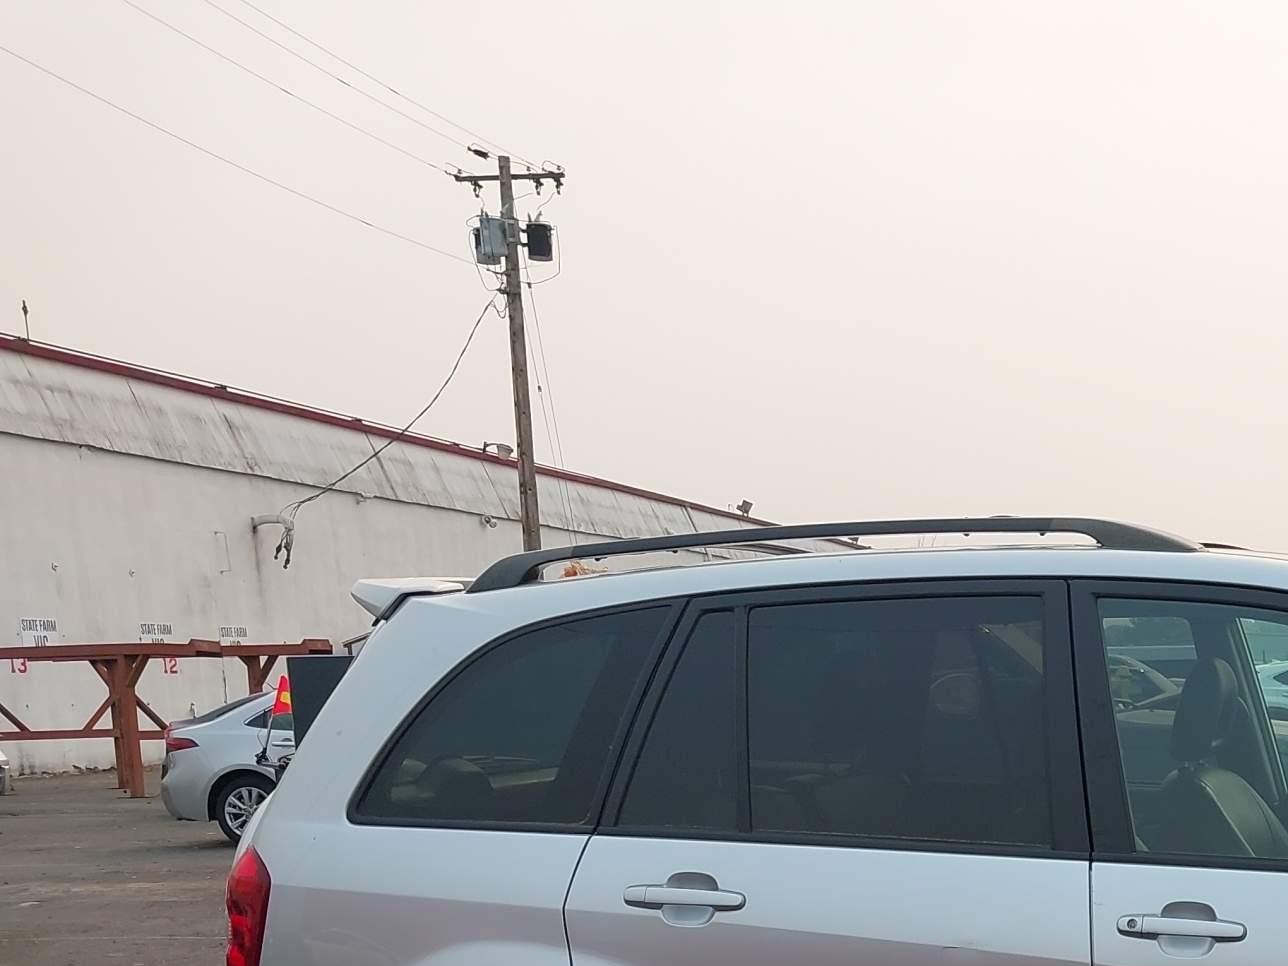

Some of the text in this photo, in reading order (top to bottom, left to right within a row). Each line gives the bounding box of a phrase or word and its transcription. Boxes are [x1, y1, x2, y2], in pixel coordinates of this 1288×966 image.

[21, 619, 57, 632] STATE FARM
[140, 623, 172, 635] STATE FARM
[220, 627, 247, 637] STATE FARM
[10, 657, 28, 673] 13
[162, 658, 178, 674] 12
